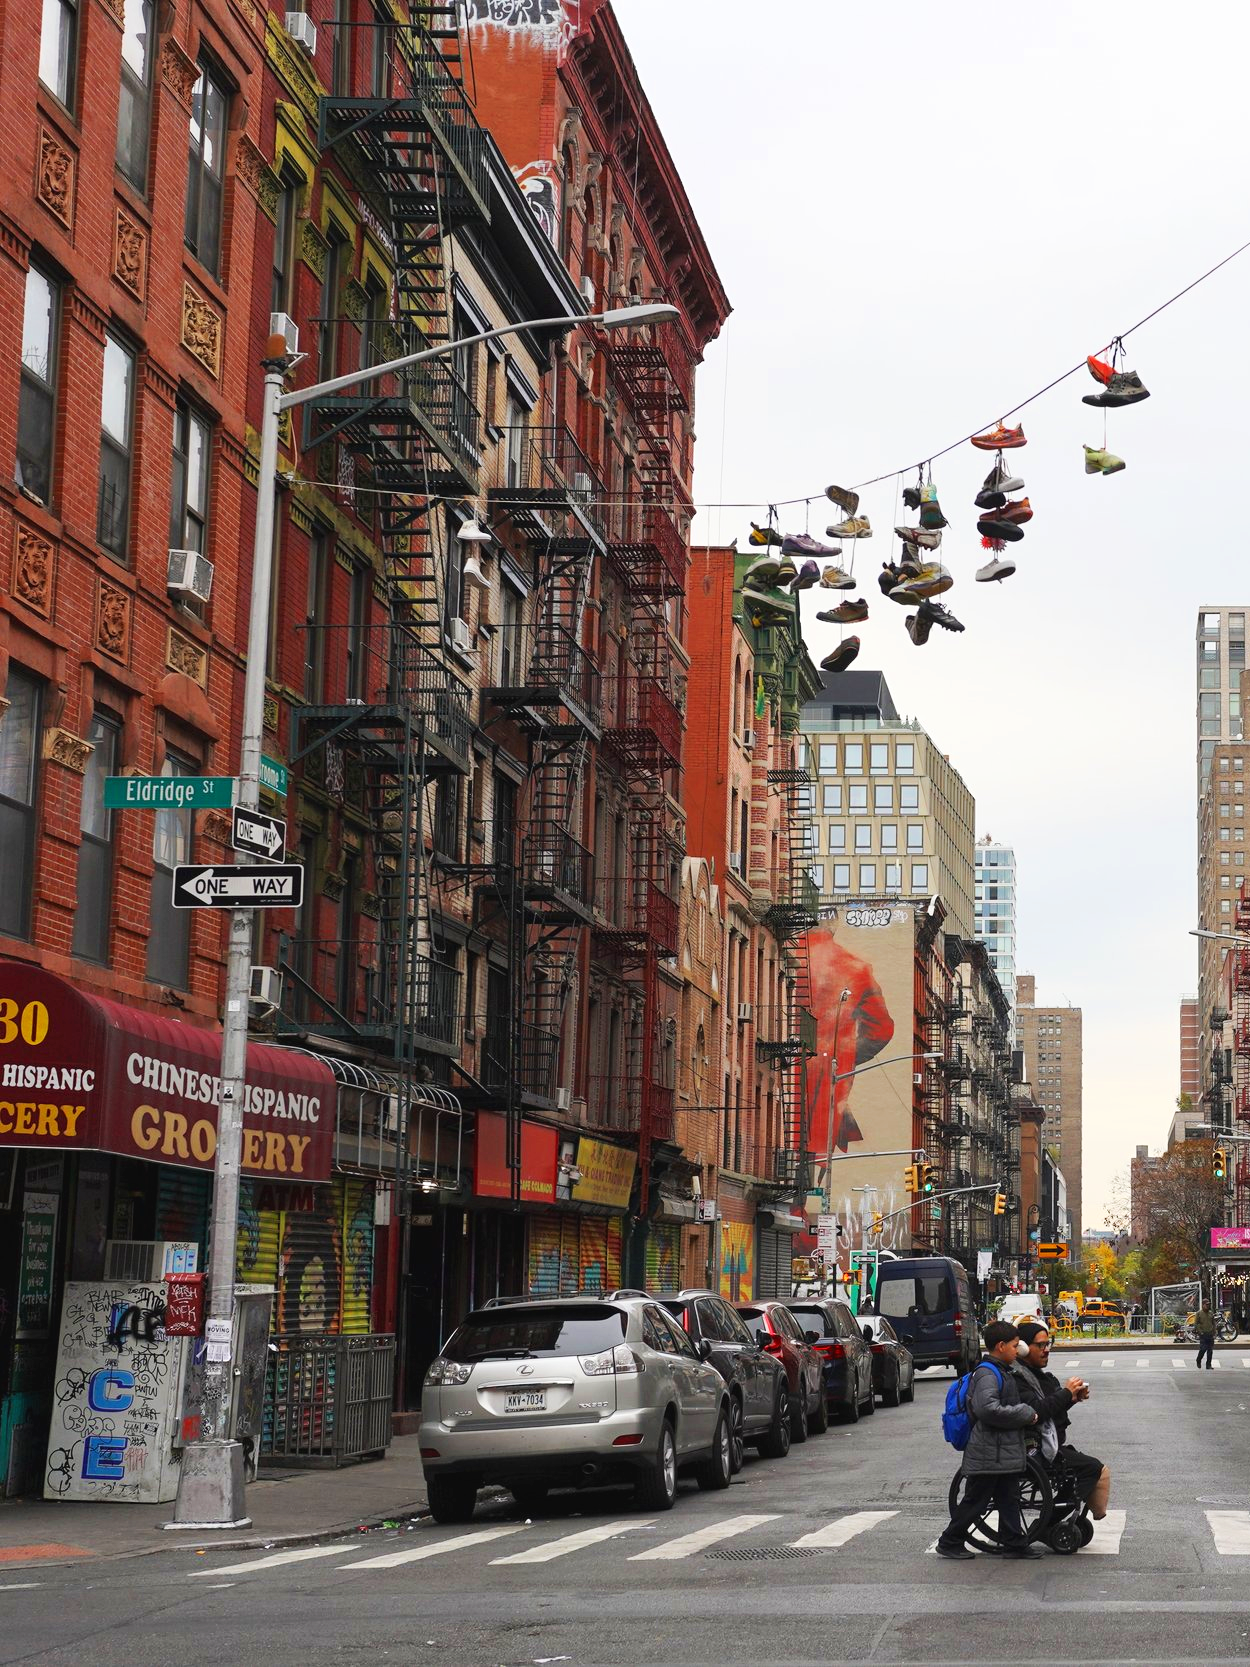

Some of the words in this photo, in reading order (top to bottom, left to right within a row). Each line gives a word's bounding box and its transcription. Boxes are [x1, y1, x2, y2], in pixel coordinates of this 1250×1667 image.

[261, 764, 279, 788] roome
[126, 780, 194, 807] Eldridge
[203, 781, 214, 793] St
[239, 822, 253, 840] ONE
[262, 829, 277, 847] WAY
[195, 879, 229, 894] ONE
[252, 878, 288, 894] WAY
[0, 998, 49, 1046] 30
[2, 1063, 95, 1092] HISPANIC
[243, 1084, 321, 1123] ISPANIC
[131, 1104, 311, 1173] GROERY
[207, 1326, 230, 1334] MOVING
